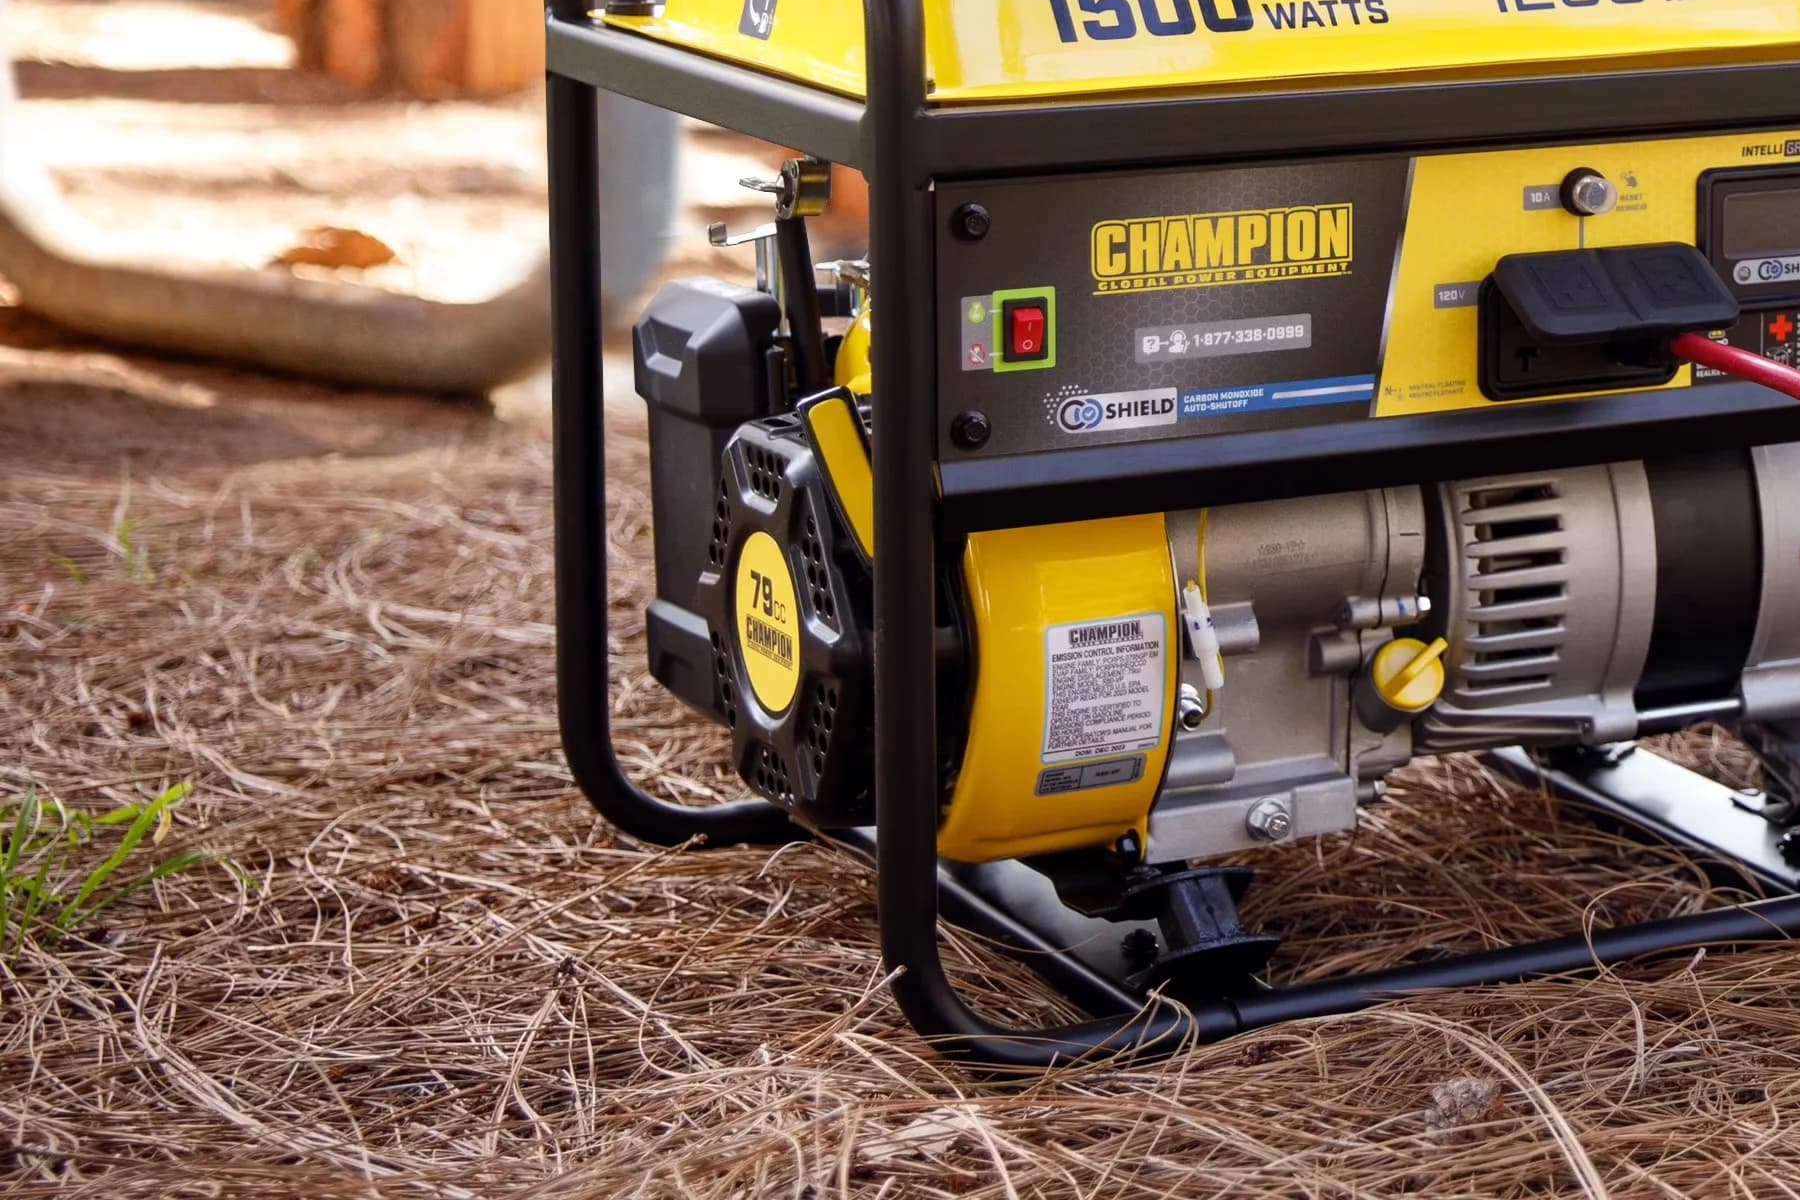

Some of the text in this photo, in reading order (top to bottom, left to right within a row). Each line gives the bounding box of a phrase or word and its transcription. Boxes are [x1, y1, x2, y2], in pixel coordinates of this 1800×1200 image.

[1096, 208, 1349, 276] CHAMPION
[1097, 262, 1349, 291] GLOBAL POWER EQUIPMENT
[1184, 388, 1264, 403] CARBON MONOXIDE
[1106, 399, 1173, 420] SHIELD
[1184, 400, 1249, 413] AUTO-SHUTOFF
[746, 616, 792, 663] CHAMPION
[1070, 622, 1140, 644] CHAMPION
[1052, 641, 1158, 662] EMISSION CONTROL INFORMATION
